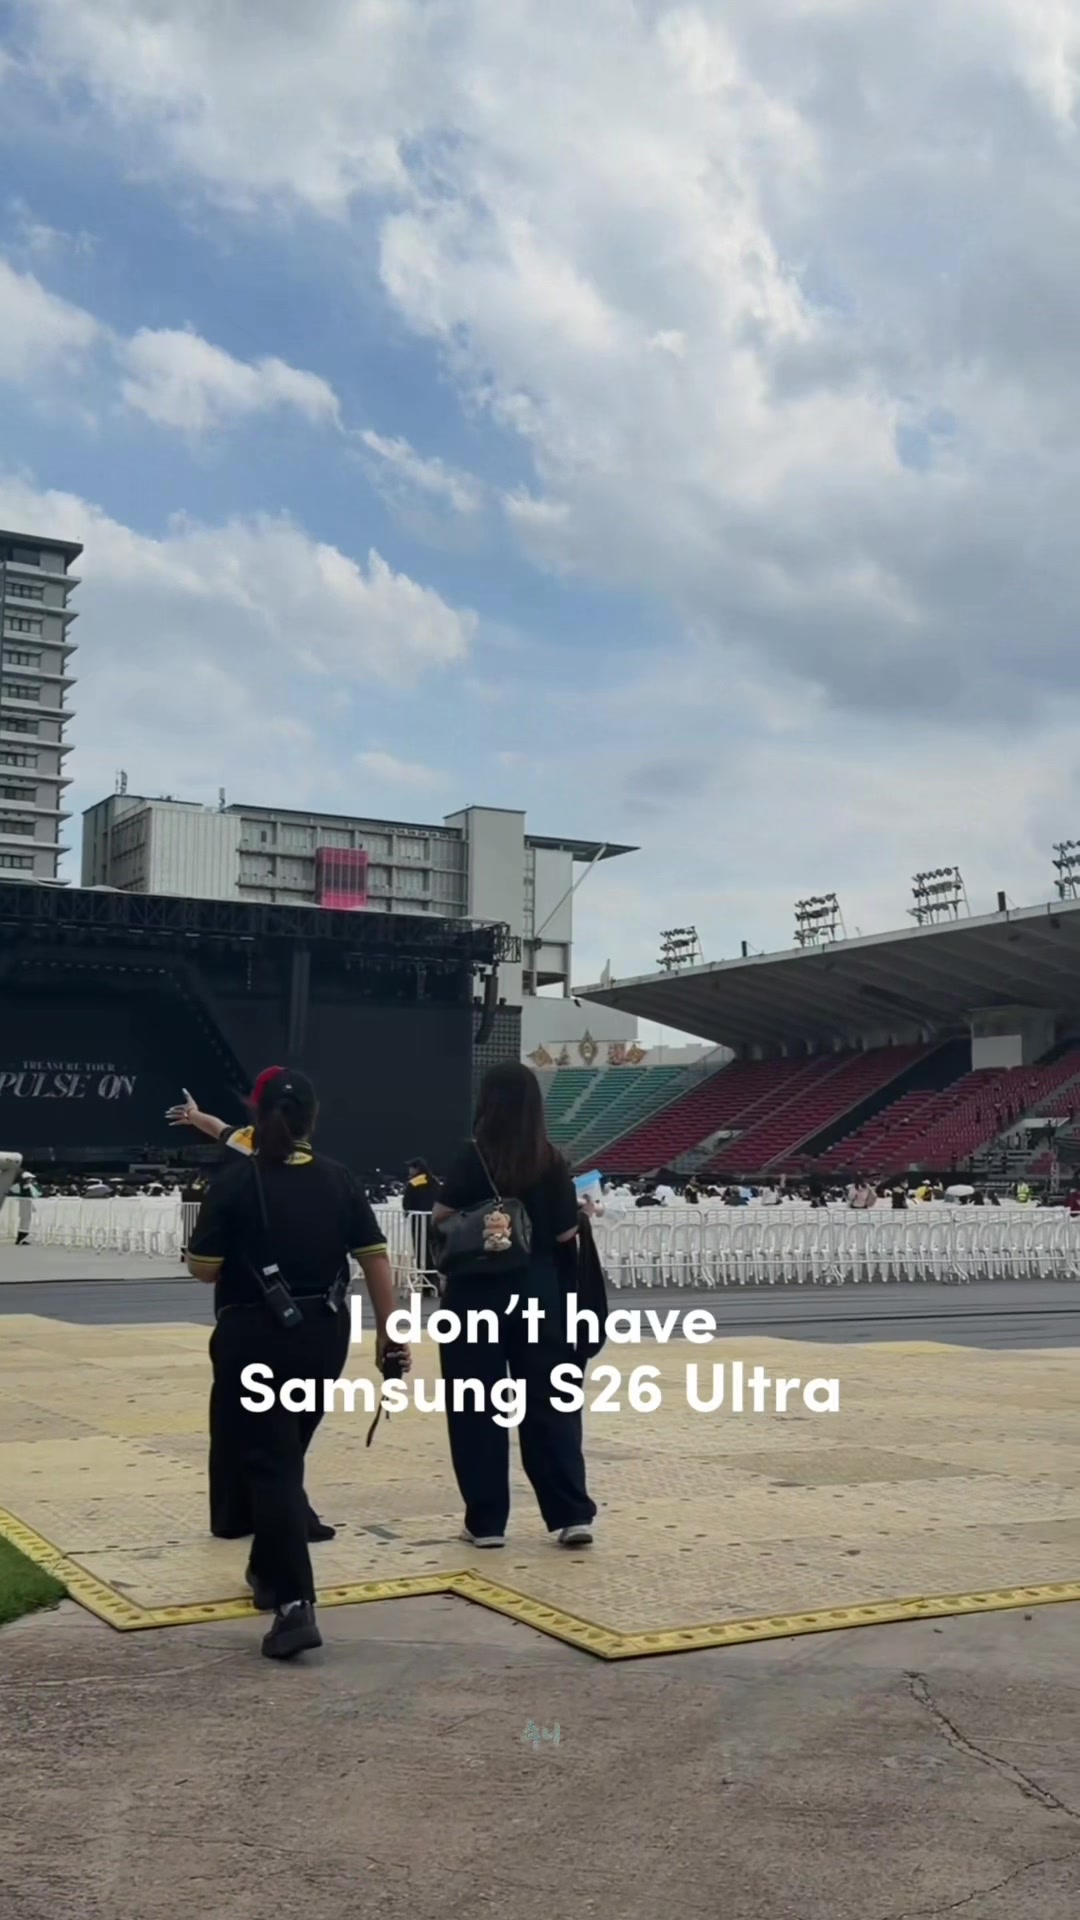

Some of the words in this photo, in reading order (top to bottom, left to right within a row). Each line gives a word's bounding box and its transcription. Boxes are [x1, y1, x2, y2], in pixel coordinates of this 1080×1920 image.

[23, 1060, 80, 1071] TREASURE
[86, 1062, 116, 1072] TOUR
[0, 1072, 91, 1098] PULSE
[98, 1074, 137, 1099] ON
